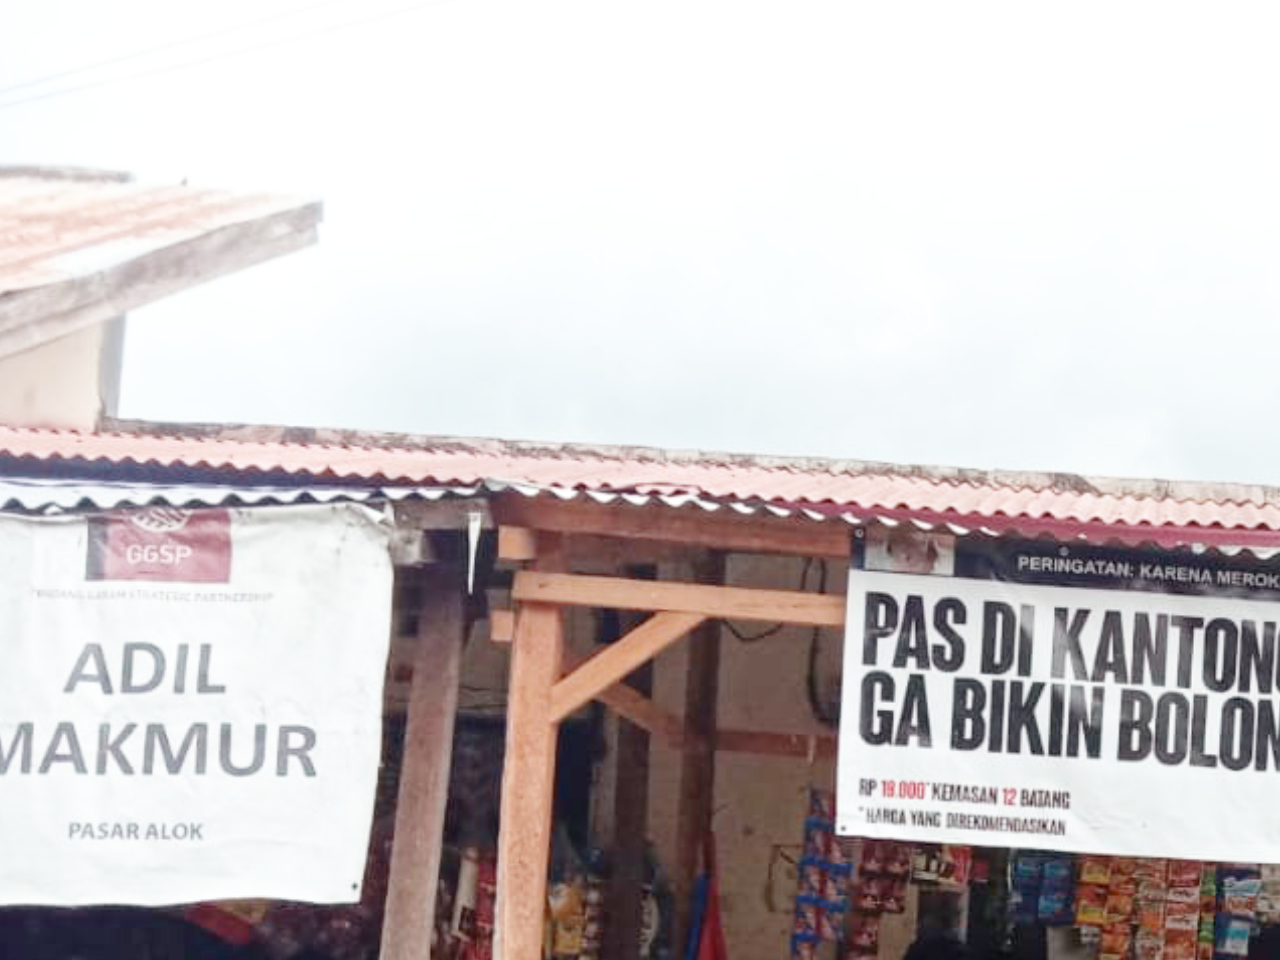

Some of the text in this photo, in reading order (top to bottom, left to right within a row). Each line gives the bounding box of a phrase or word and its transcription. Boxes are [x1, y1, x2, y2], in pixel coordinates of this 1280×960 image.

[126, 544, 192, 565] GGSP
[1018, 555, 1134, 578] PERINGATAN:
[1139, 564, 1212, 584] KARENA
[861, 590, 967, 673] PAS
[980, 600, 1035, 678] DI
[62, 641, 227, 695] ADIL
[858, 670, 932, 748] GA
[949, 677, 1104, 759] BIKIN
[0, 721, 318, 778] MAKMUR
[858, 777, 878, 798] RP
[931, 782, 999, 806] KEMASAN
[1002, 787, 1017, 806] 12
[1019, 788, 1072, 810] BATANG
[68, 821, 205, 842] PASAR ALOK
[910, 811, 942, 829] YANG
[946, 811, 1067, 837] DIREKOMENDASIKAN
